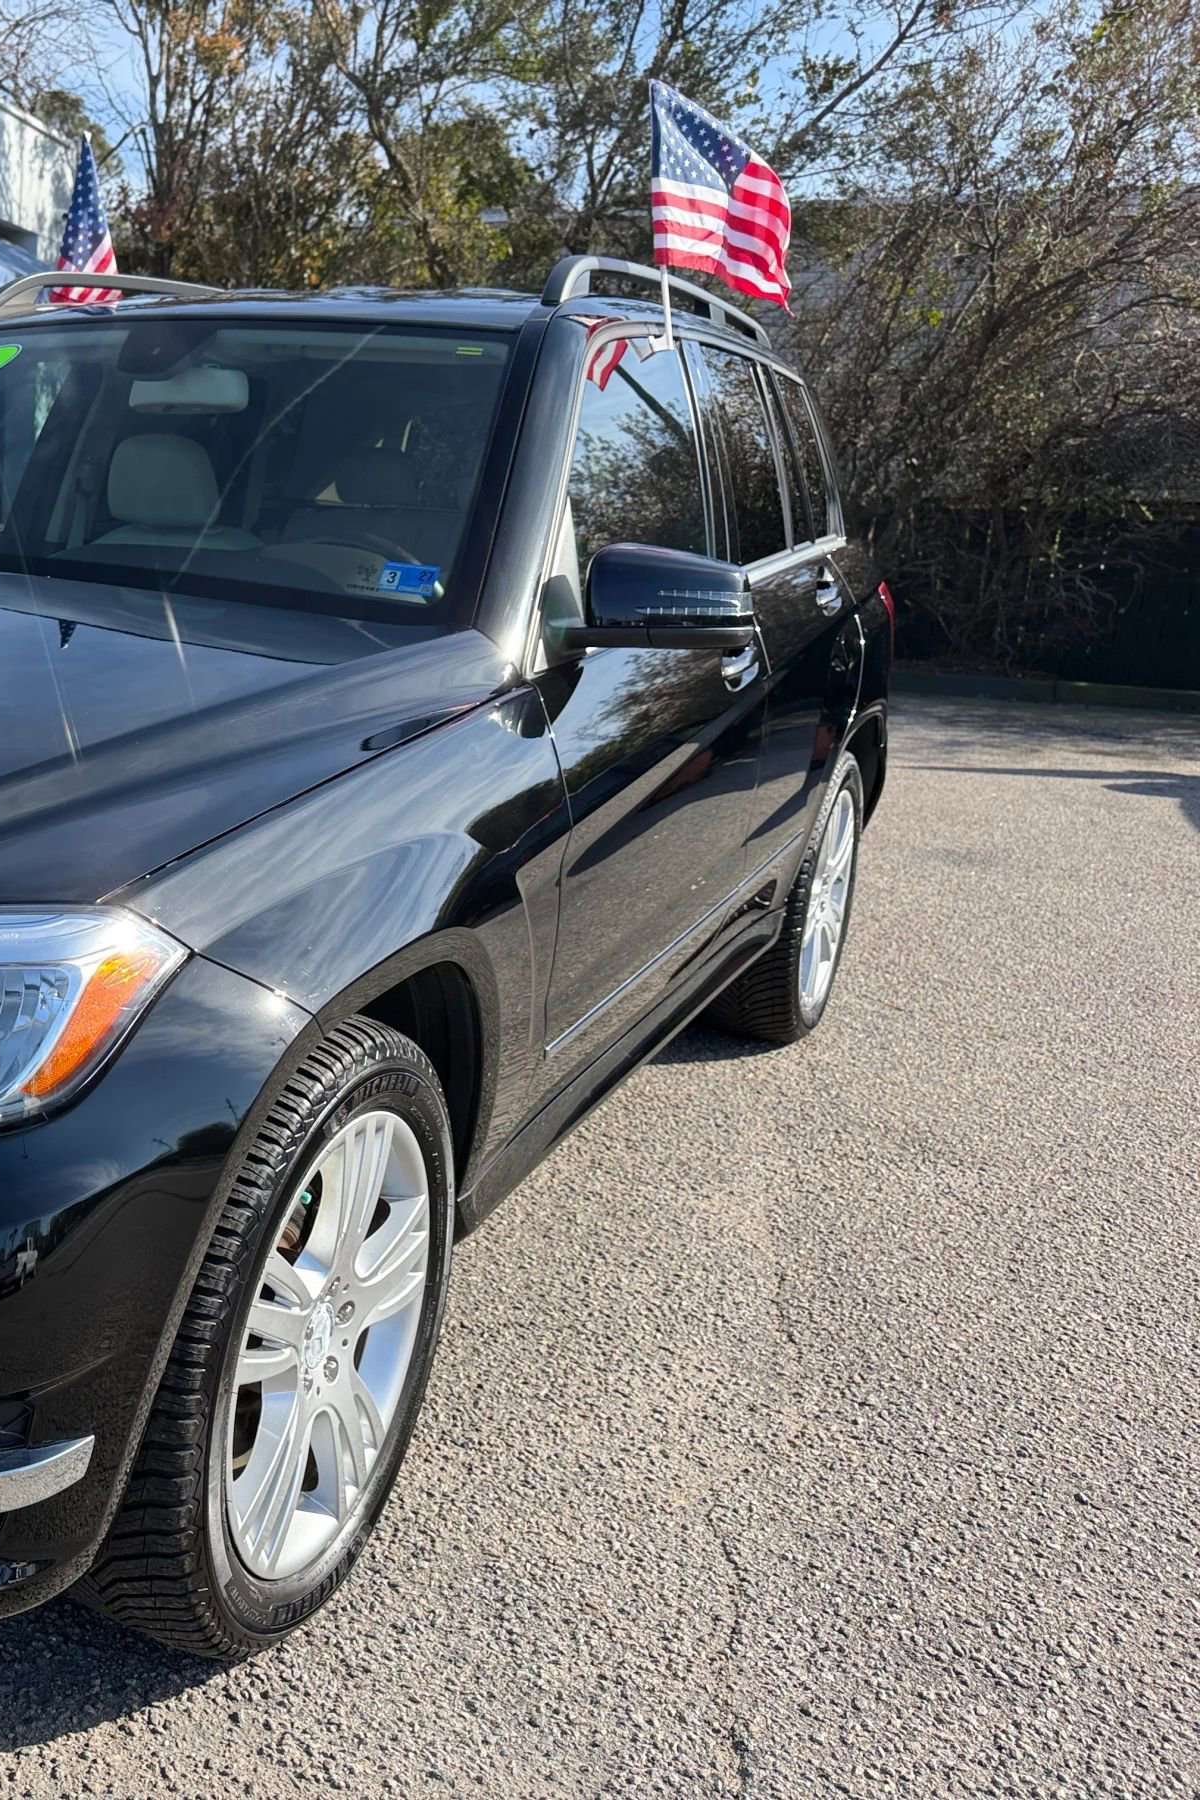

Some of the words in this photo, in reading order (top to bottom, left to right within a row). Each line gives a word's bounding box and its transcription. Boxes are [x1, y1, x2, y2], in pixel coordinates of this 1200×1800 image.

[386, 571, 397, 584] 3
[417, 570, 435, 582] 27
[353, 1073, 419, 1105] MICHELIN
